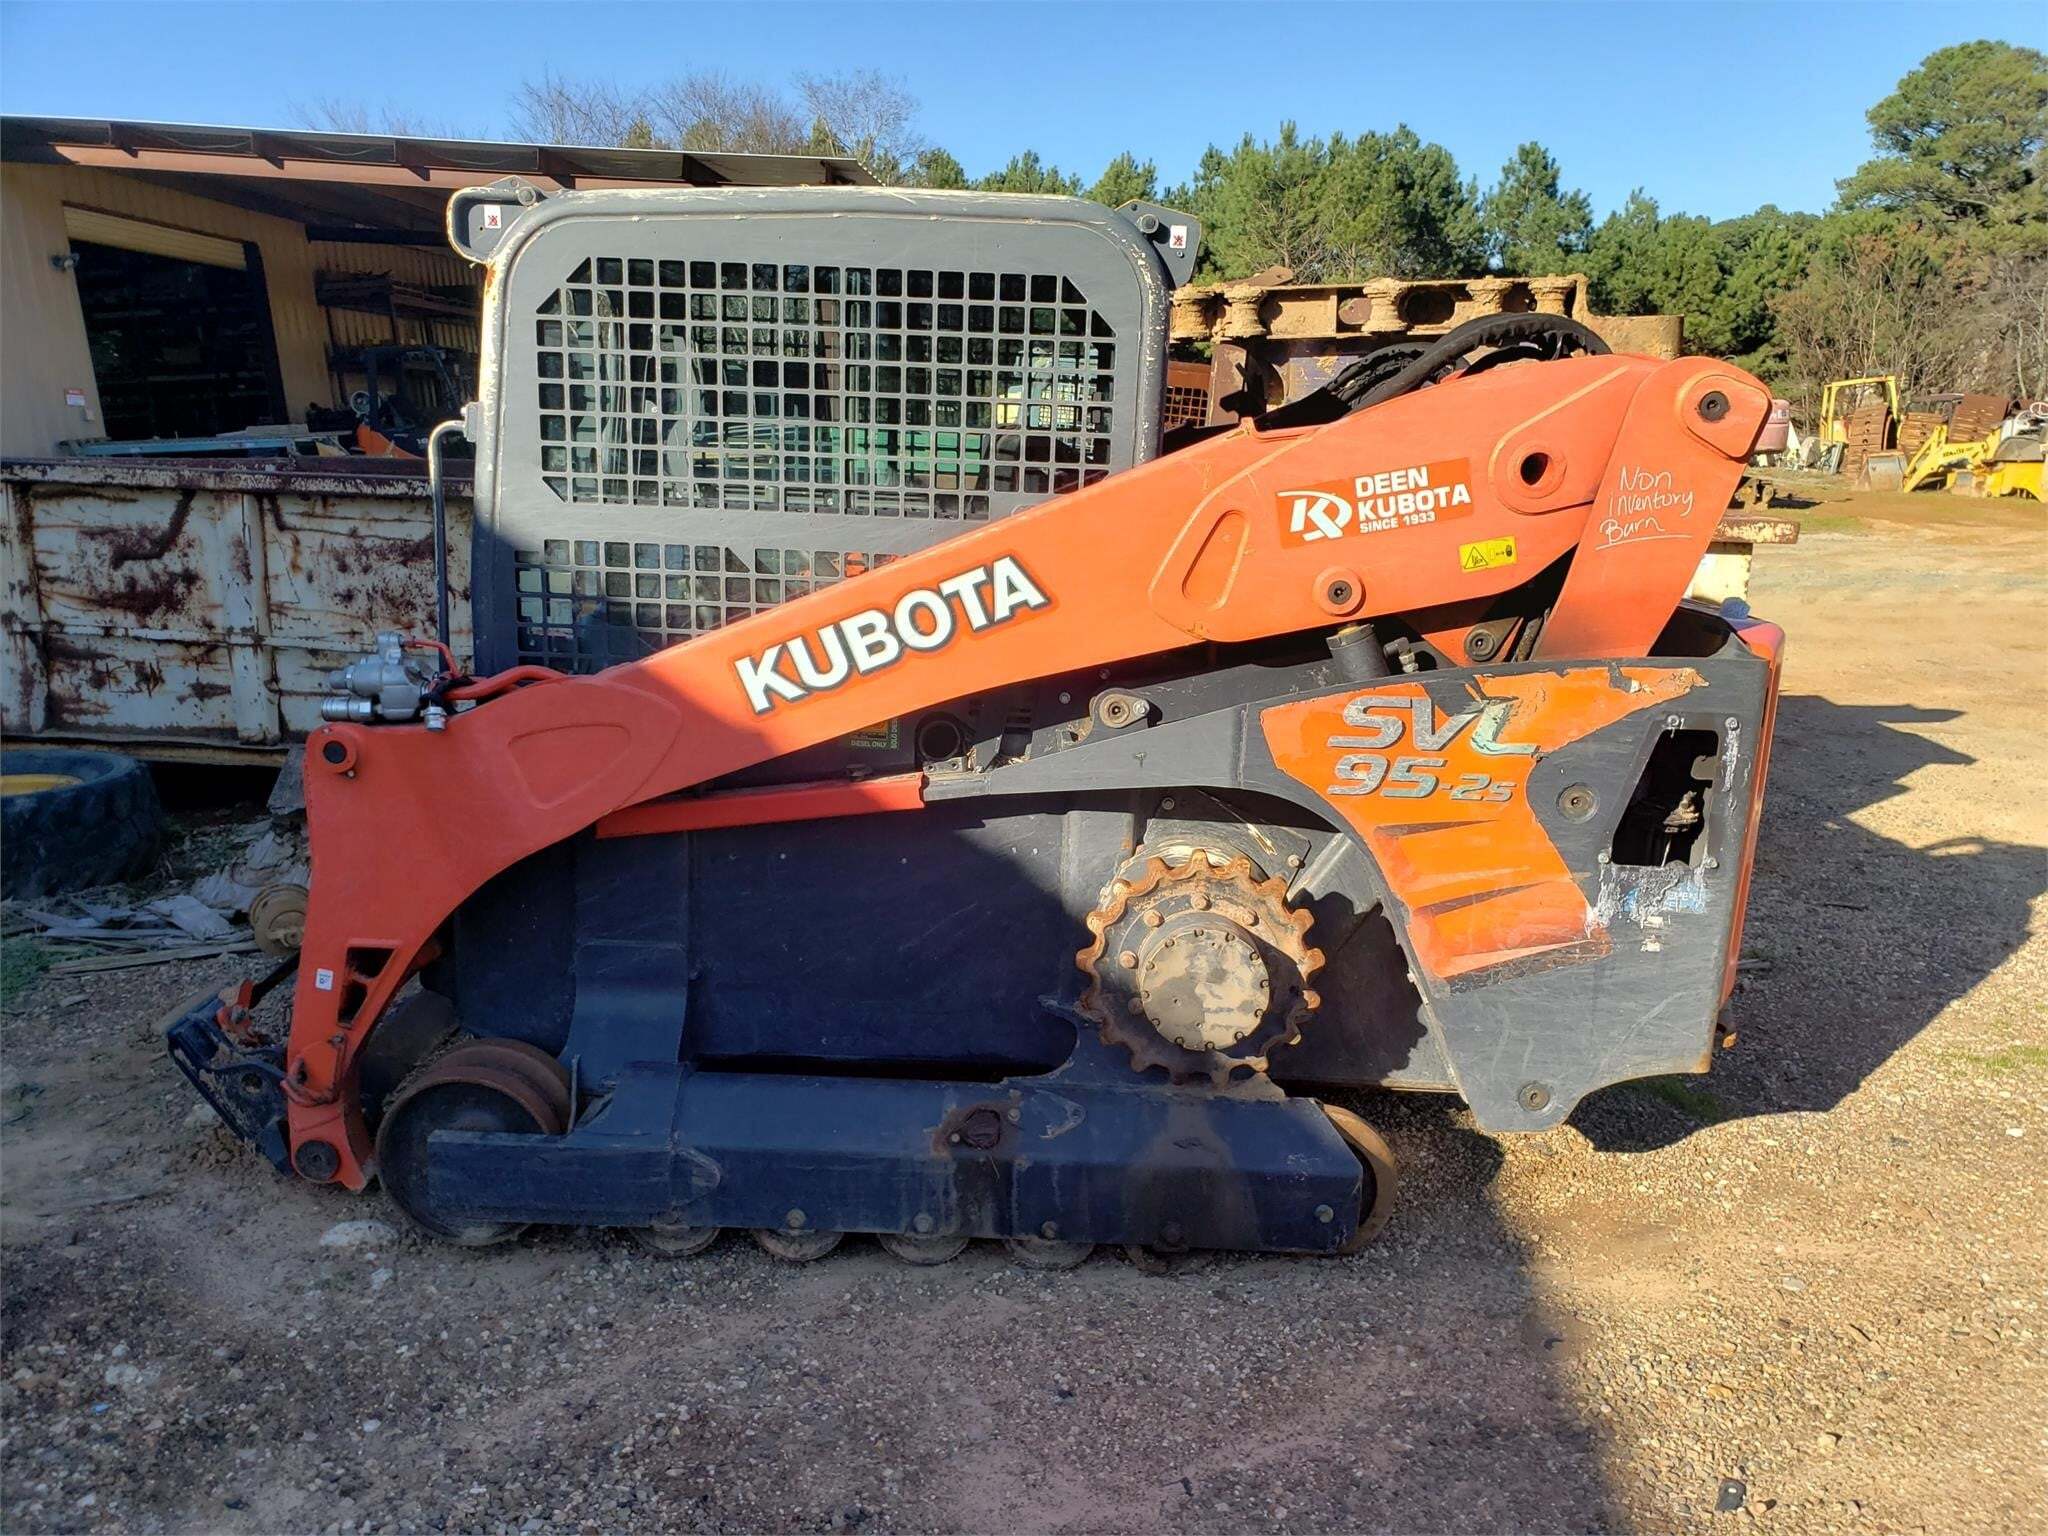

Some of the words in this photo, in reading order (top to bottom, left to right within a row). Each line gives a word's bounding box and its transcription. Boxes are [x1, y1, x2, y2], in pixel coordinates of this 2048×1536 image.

[1355, 465, 1429, 499] DEEN
[1619, 465, 1673, 492] Non
[1357, 483, 1472, 522] KUBOTA
[1360, 517, 1399, 534] SINCE
[1403, 511, 1436, 527] 1933
[733, 555, 1050, 714] KUBOTA
[1327, 695, 1541, 755] SVL
